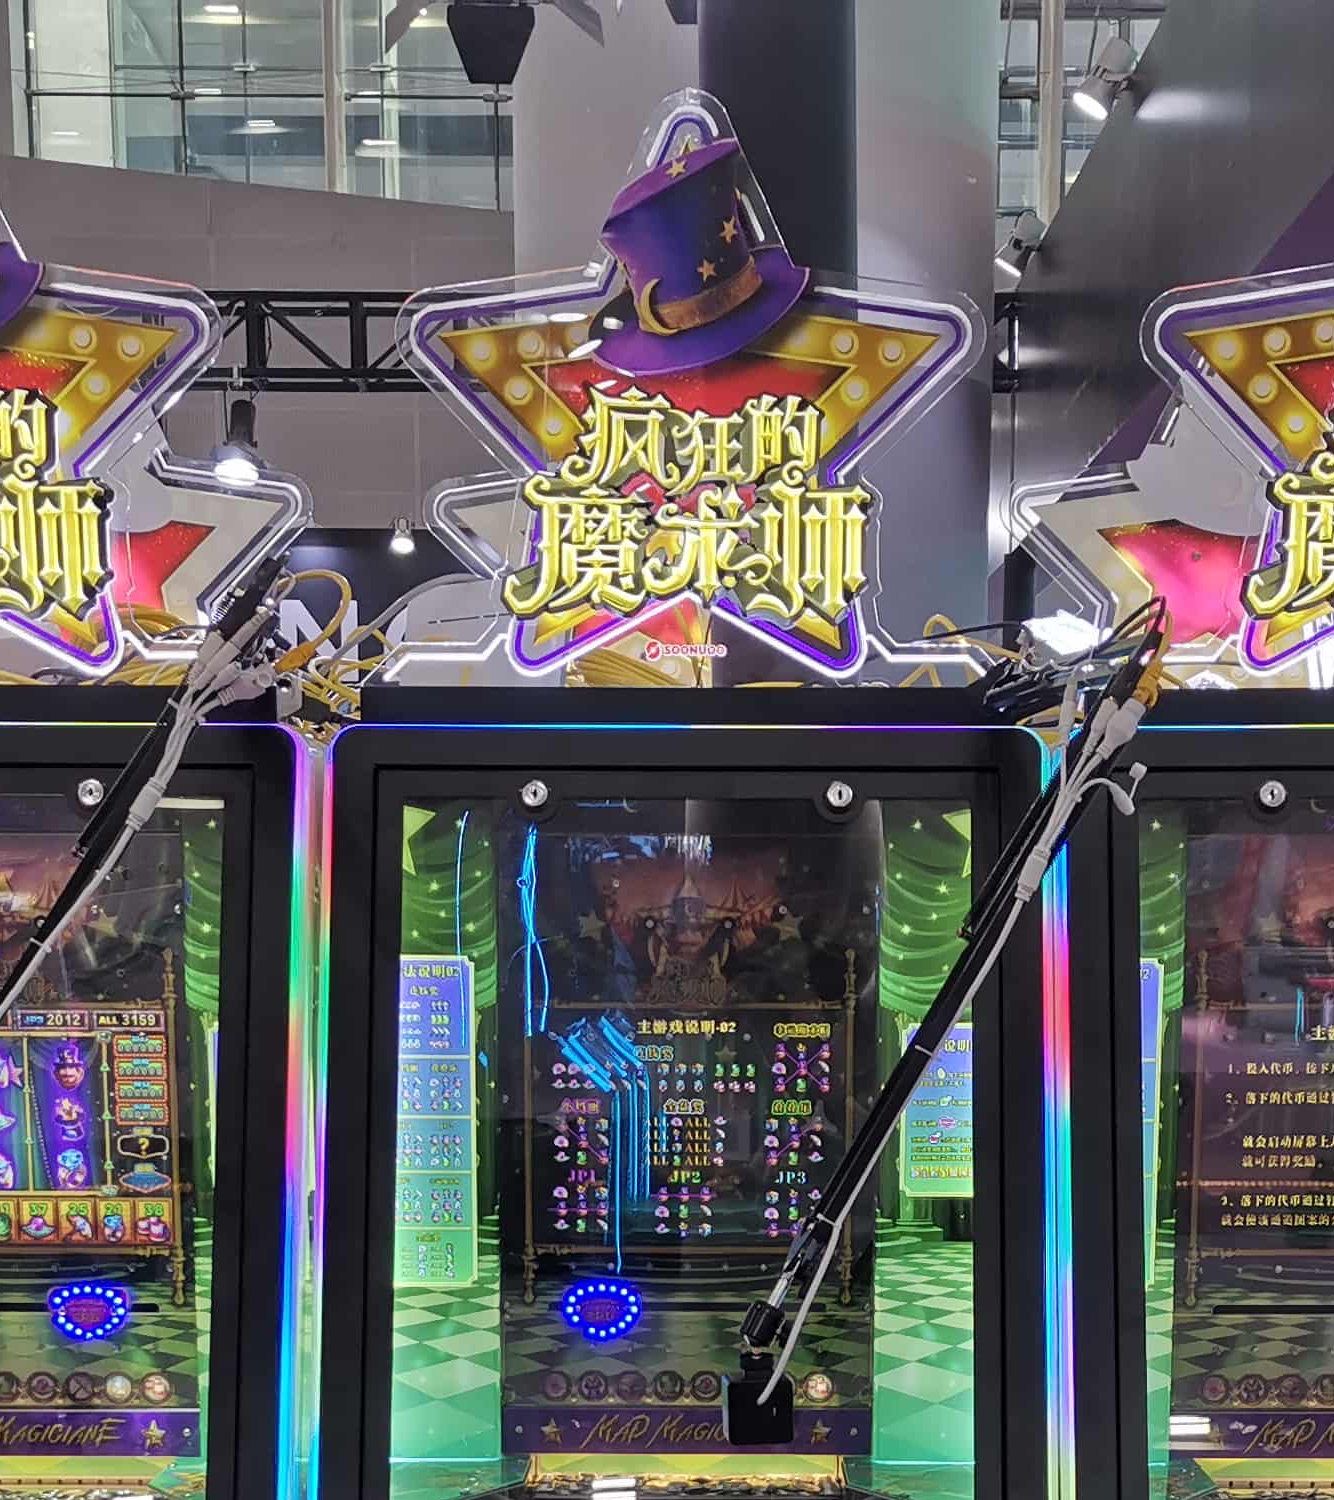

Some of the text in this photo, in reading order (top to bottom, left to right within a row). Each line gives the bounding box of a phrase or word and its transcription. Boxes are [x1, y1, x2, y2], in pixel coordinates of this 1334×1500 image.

[562, 387, 821, 495] 疯狂的
[504, 473, 872, 616] 魔术师
[46, 1012, 82, 1026] 2012
[98, 1012, 156, 1026] ALL 3159
[637, 1019, 737, 1035] 主游戏说明-02
[567, 1169, 596, 1184] JP1
[668, 1169, 702, 1184] JP2
[775, 1169, 808, 1185] JP3
[648, 1413, 729, 1446] MAGIC
